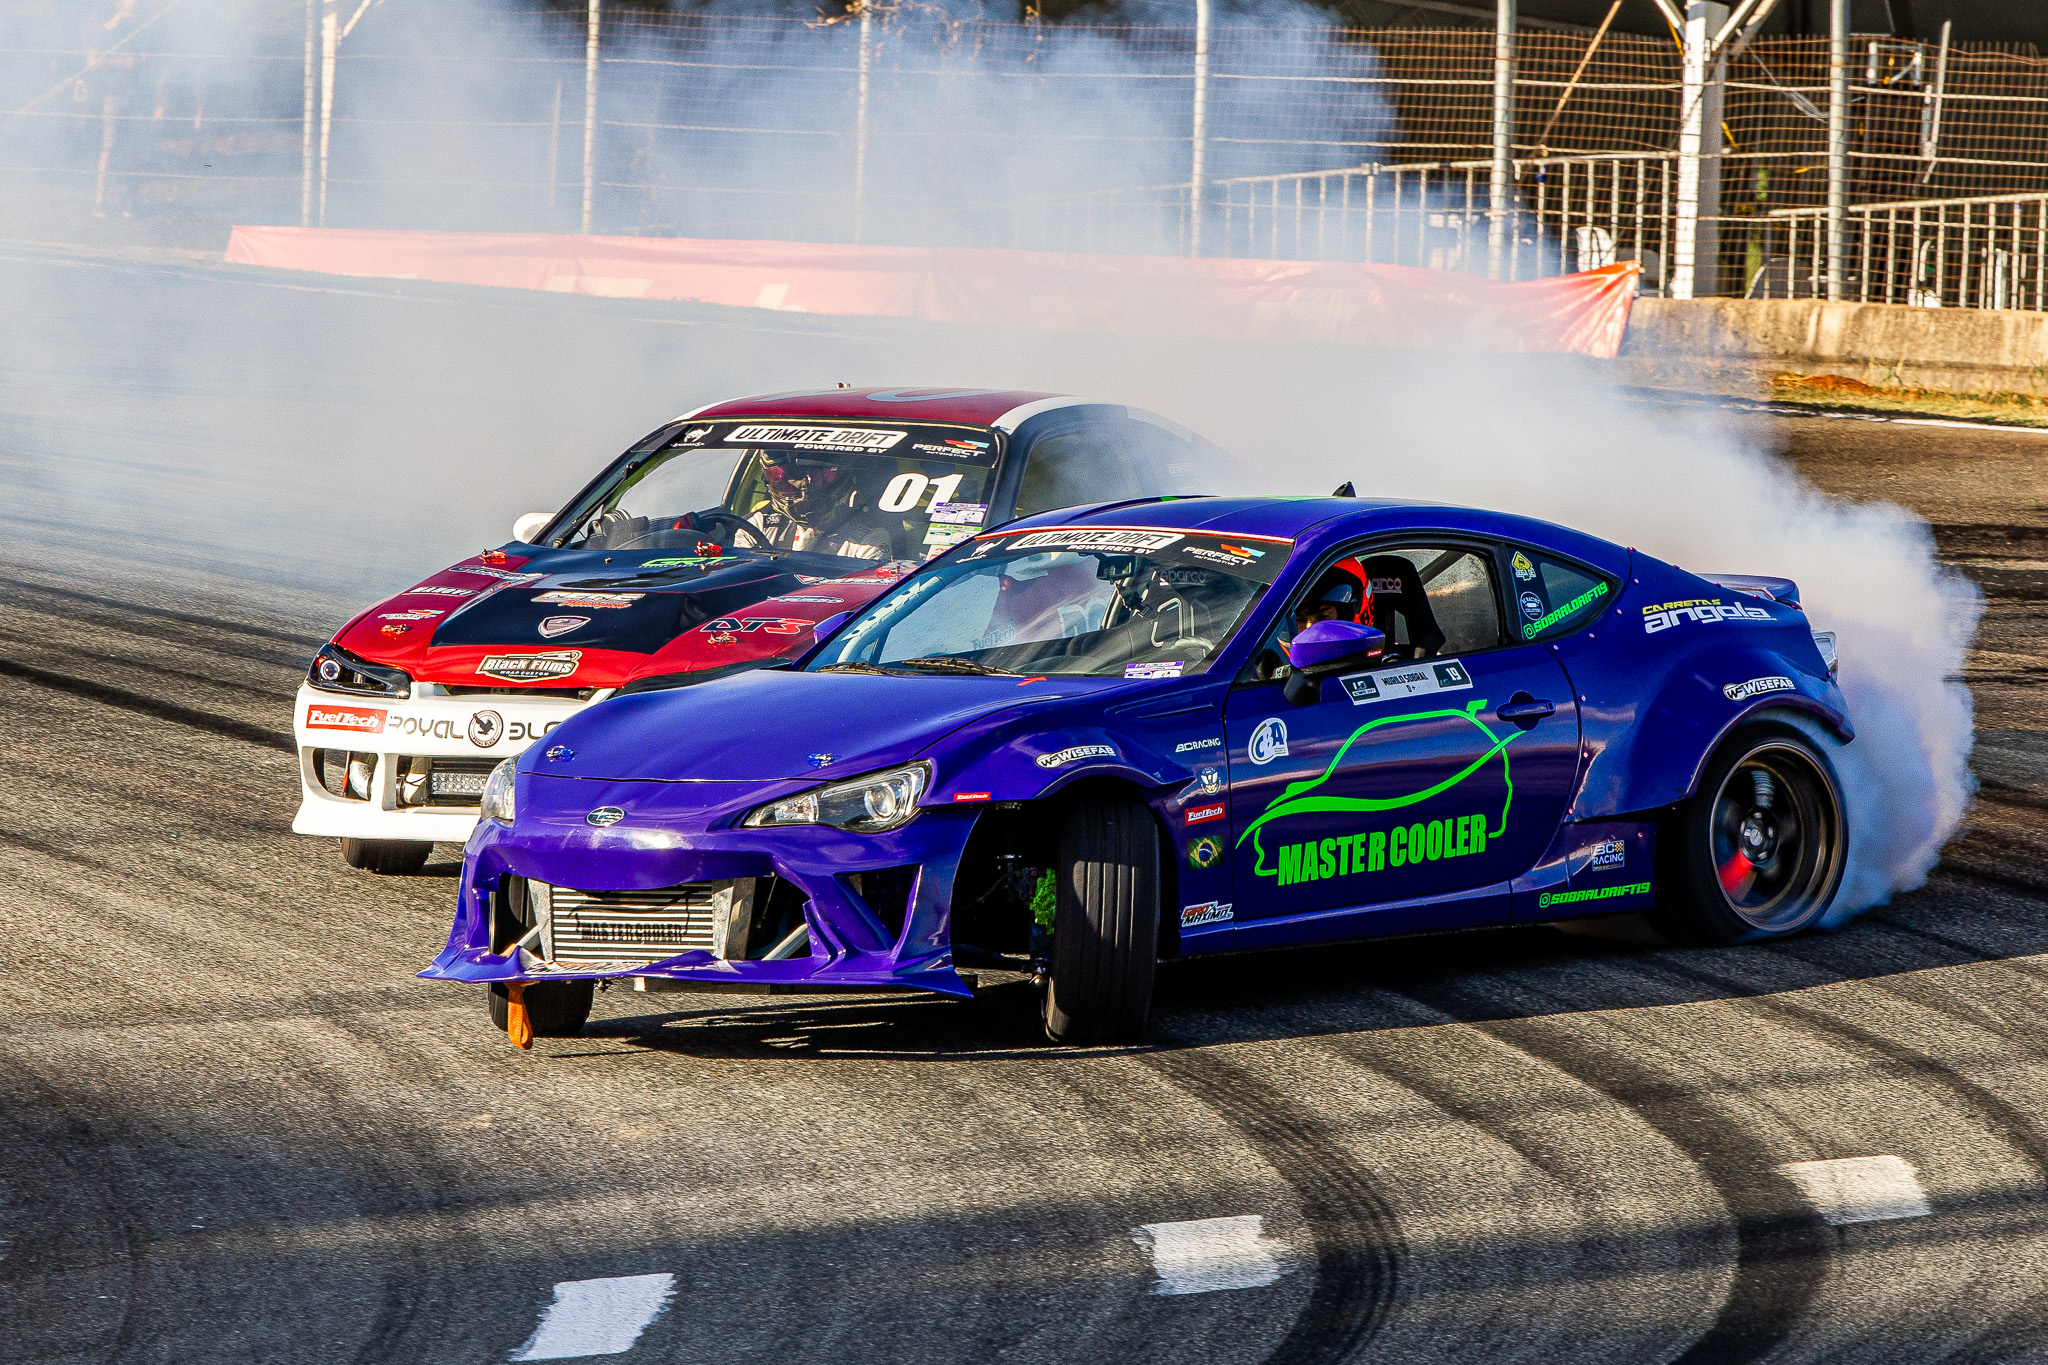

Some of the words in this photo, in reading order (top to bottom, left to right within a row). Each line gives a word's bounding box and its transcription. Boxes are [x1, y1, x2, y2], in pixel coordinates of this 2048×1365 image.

[737, 427, 830, 442] ULTIMATE
[829, 430, 897, 446] DRIFT
[794, 443, 865, 452] POWERED
[911, 443, 986, 457] PERFECT
[878, 472, 964, 513] 01
[1021, 532, 1112, 547] ULTIMATE
[1112, 531, 1174, 549] DRIFT
[1067, 544, 1131, 552] POWERED
[1182, 546, 1257, 565] PERFECT
[1194, 555, 1235, 566] AUTOMOTIVE
[1160, 570, 1207, 586] sparco
[1371, 577, 1402, 591] arco
[1642, 599, 1721, 615] CARRETAS
[1643, 601, 1772, 634] angola
[483, 659, 529, 671] Black
[530, 659, 574, 673] Films
[1403, 671, 1429, 683] SOBRAL
[1446, 667, 1462, 681] 19
[1743, 680, 1795, 695] WISEFAB
[308, 710, 380, 728] FuelTech
[389, 716, 464, 739] ROYAL
[1058, 747, 1115, 761] WISEFAB
[1187, 807, 1223, 822] FuelTech
[1278, 831, 1386, 886] MASTER
[1390, 813, 1487, 867] COOLER
[1593, 843, 1615, 856] BC
[1593, 853, 1624, 866] RACING
